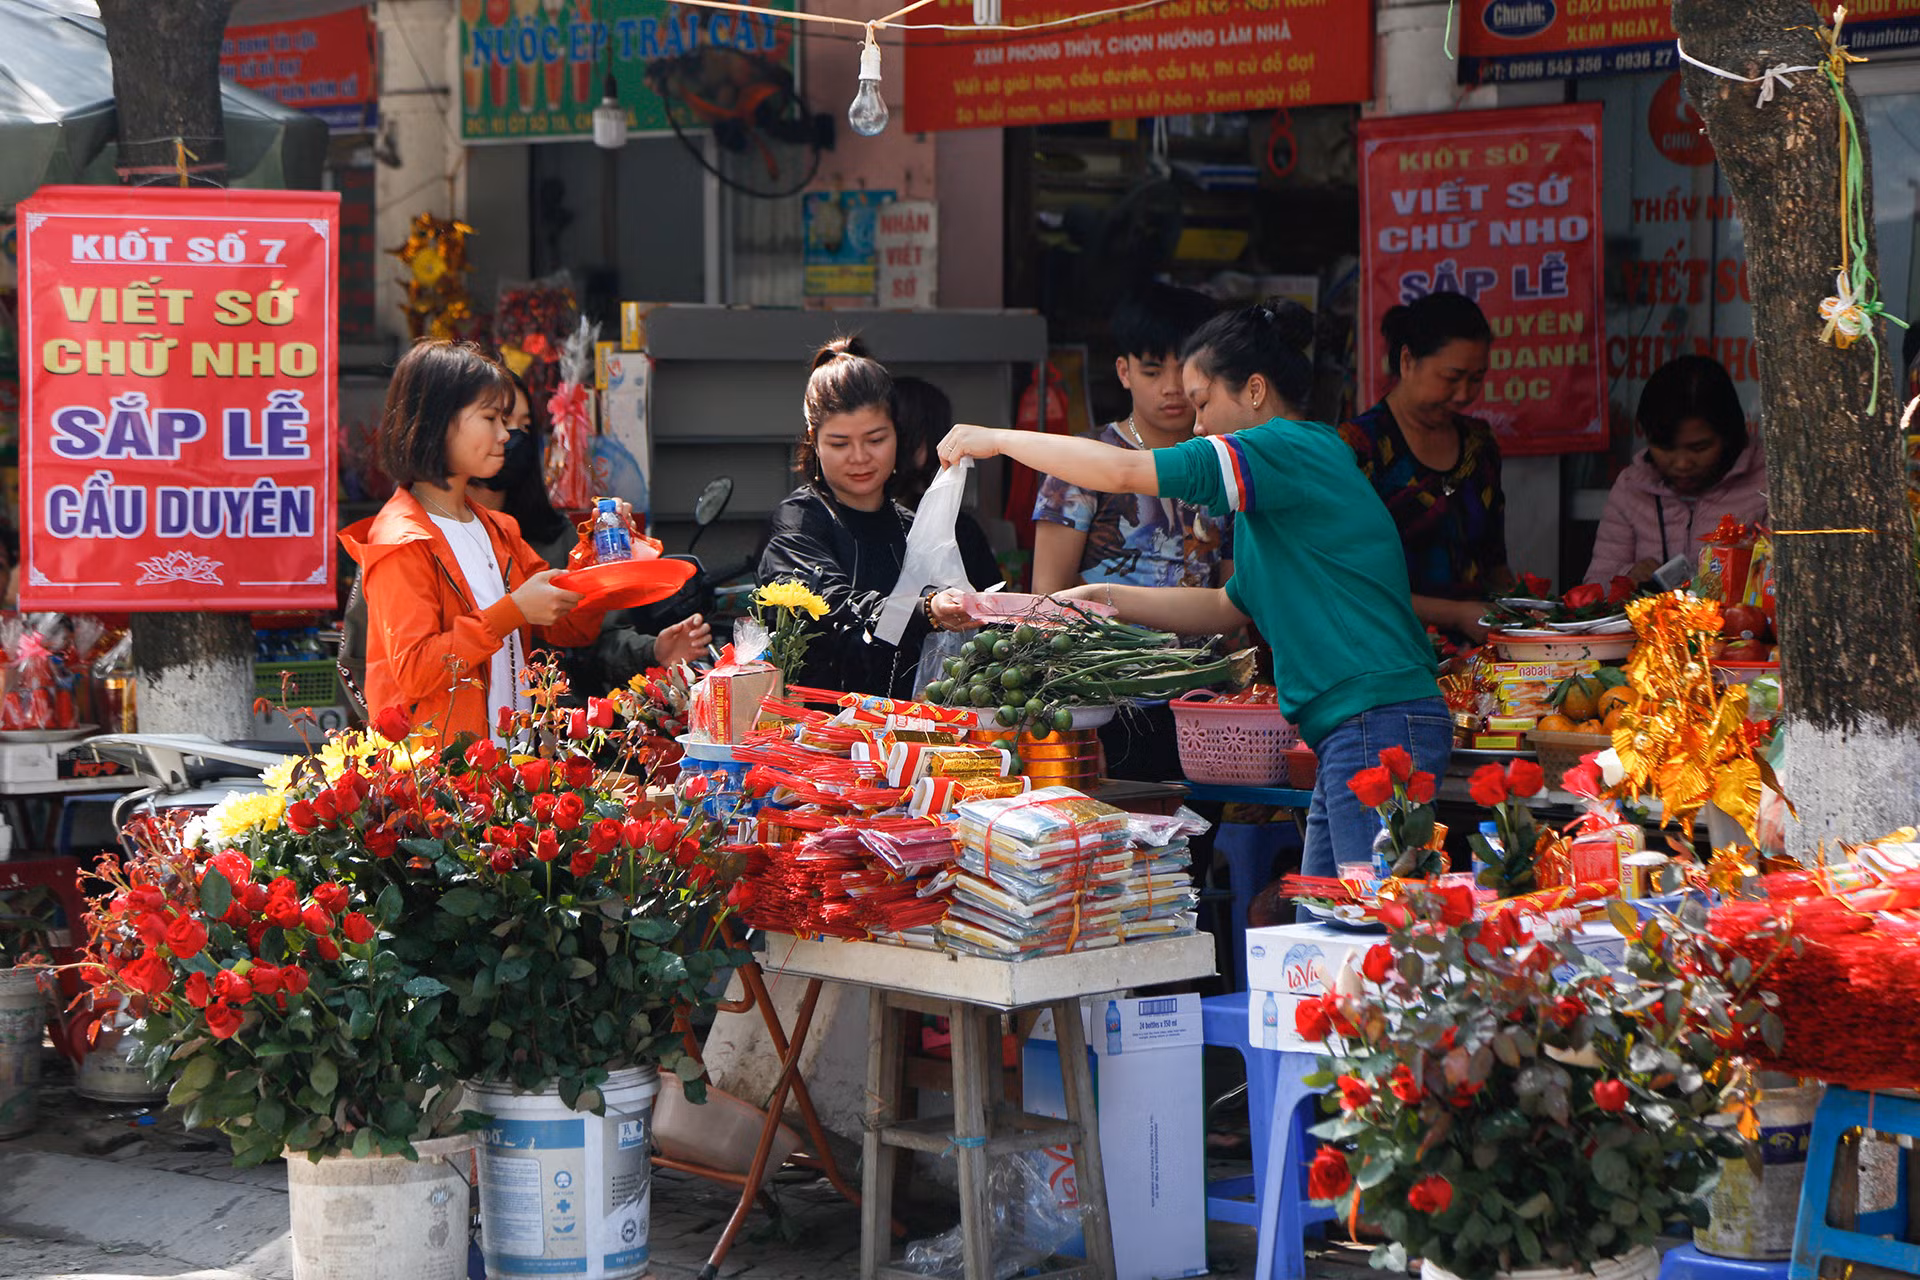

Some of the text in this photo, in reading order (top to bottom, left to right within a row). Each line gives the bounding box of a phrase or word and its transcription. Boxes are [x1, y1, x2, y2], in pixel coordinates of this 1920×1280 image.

[974, 47, 1004, 66] XEM
[1007, 42, 1060, 62] PHONG
[1256, 18, 1291, 43] NHÀ
[1399, 138, 1561, 171] KIỐT SỐ 7
[1391, 172, 1572, 216] VIẾT SỚ
[71, 227, 287, 264] KIỐT SỐ 7
[1378, 215, 1589, 253] CHỮ NHO
[1511, 251, 1569, 300] LỄ
[59, 276, 299, 326] VIẾT SỚ
[1490, 310, 1584, 338] UYÊN
[42, 333, 318, 377] CHỮ NHO
[1490, 345, 1589, 371] DANH
[1484, 377, 1551, 405] LỘC
[51, 389, 310, 460] SẮP LỄ
[45, 470, 315, 539] CẦU DUYÊN
[1519, 666, 1551, 676] nabati
